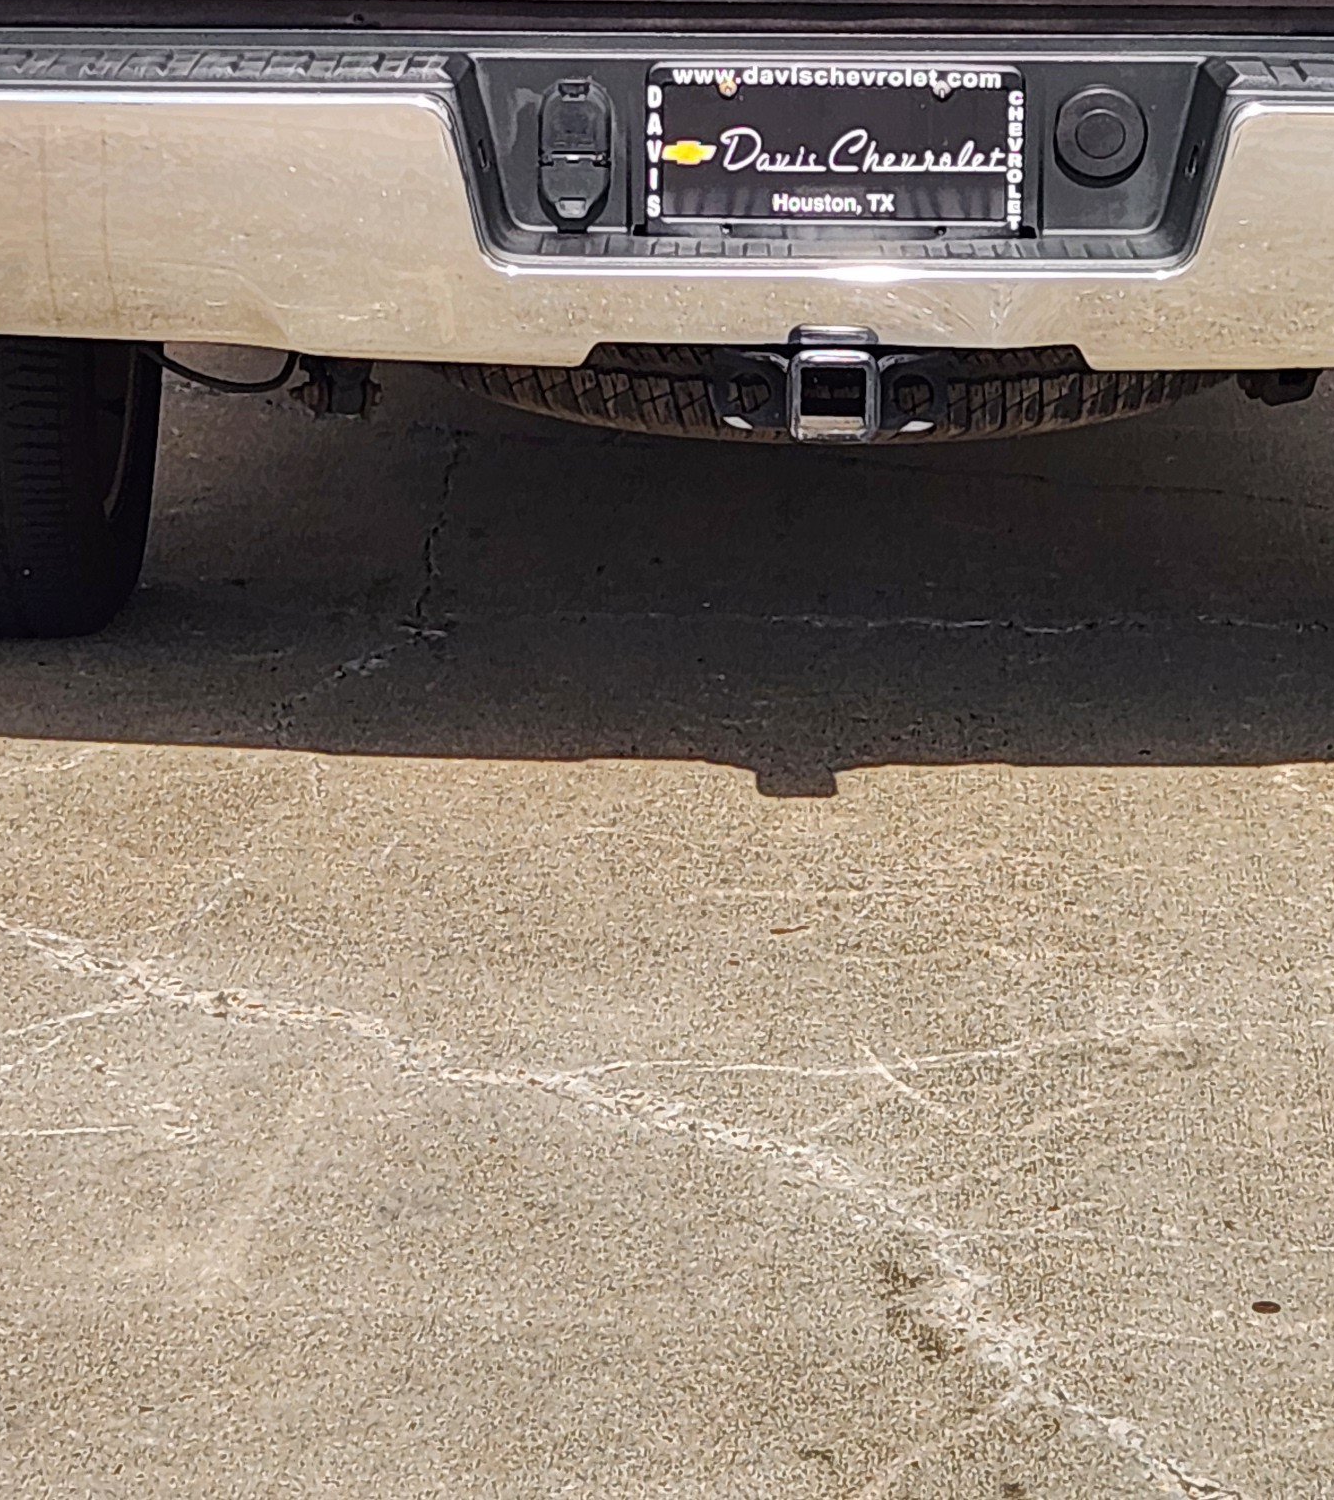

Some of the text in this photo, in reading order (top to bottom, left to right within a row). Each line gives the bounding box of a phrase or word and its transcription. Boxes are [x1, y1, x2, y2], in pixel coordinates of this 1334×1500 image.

[672, 66, 1002, 89] www.davischevroletcom
[647, 86, 663, 218] DAVIS
[720, 128, 1007, 173] Davis Chevrolet
[1007, 90, 1023, 230] CHEVROLET
[773, 193, 895, 215] Houston, TX
